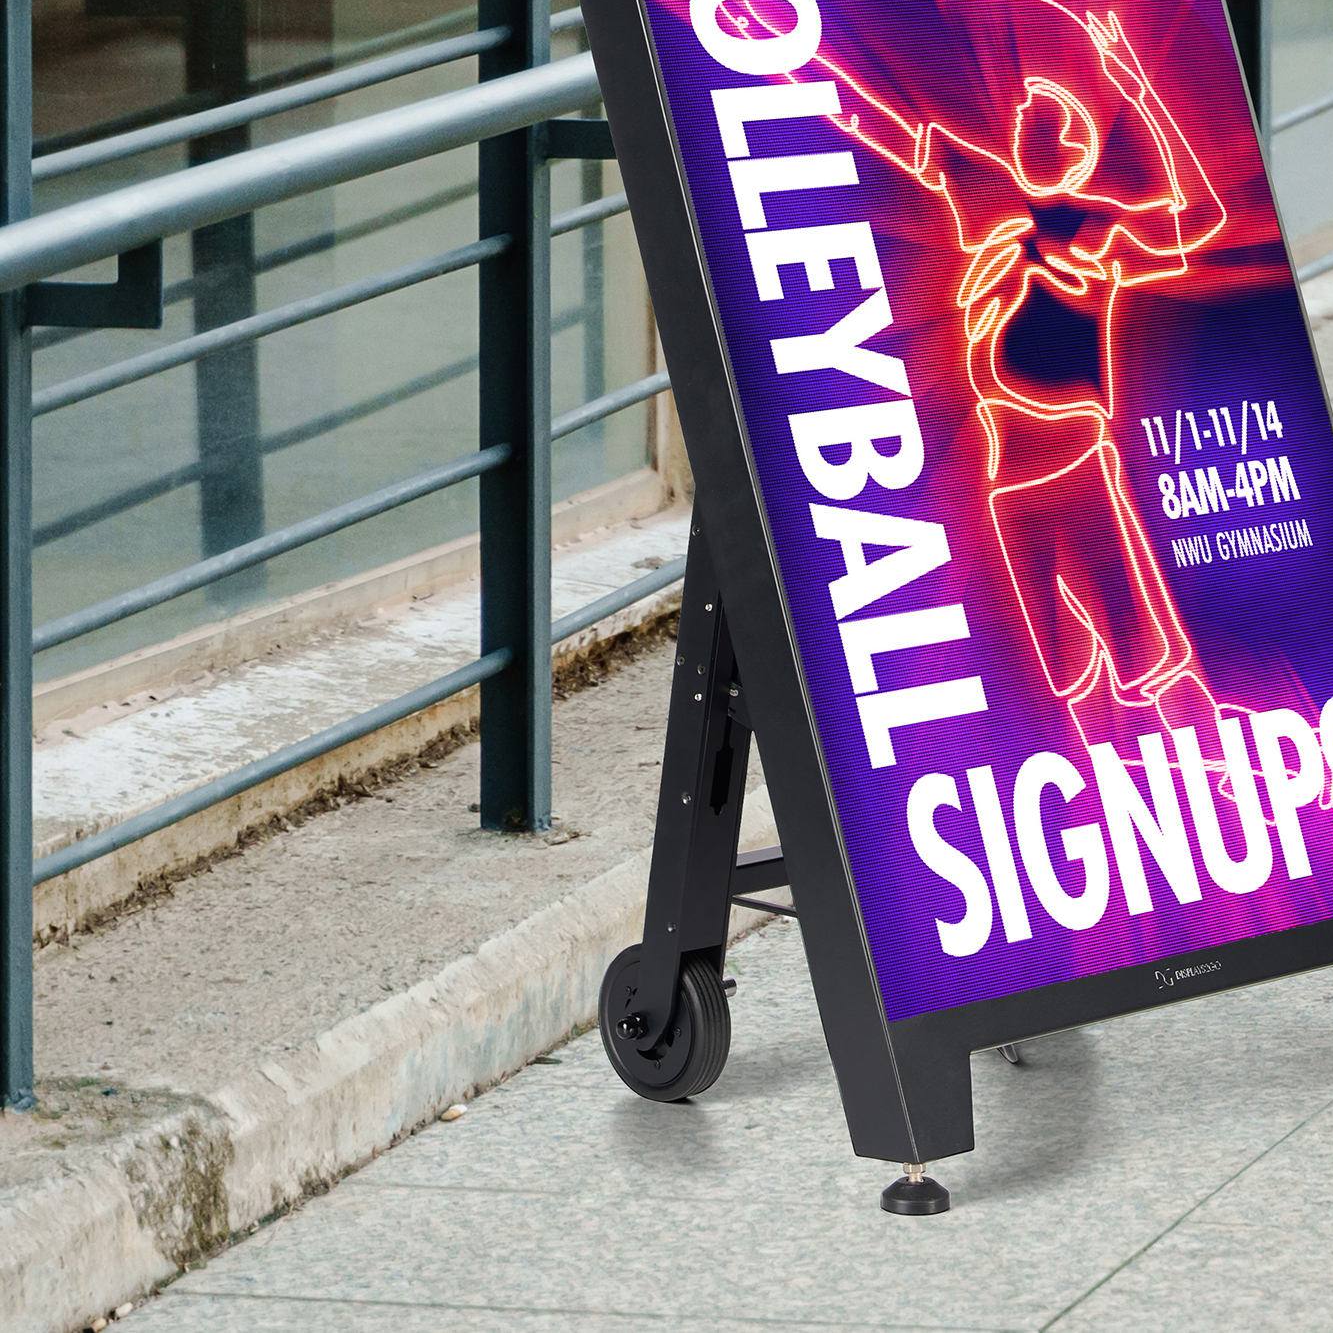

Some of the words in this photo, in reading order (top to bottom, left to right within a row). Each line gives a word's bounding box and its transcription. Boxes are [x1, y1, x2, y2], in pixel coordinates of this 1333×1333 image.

[1141, 400, 1283, 465] 11/1-11/14
[1158, 455, 1301, 520] 8AM-4PM
[1171, 534, 1213, 568] NWU
[1216, 518, 1314, 561] GYMNASIUM
